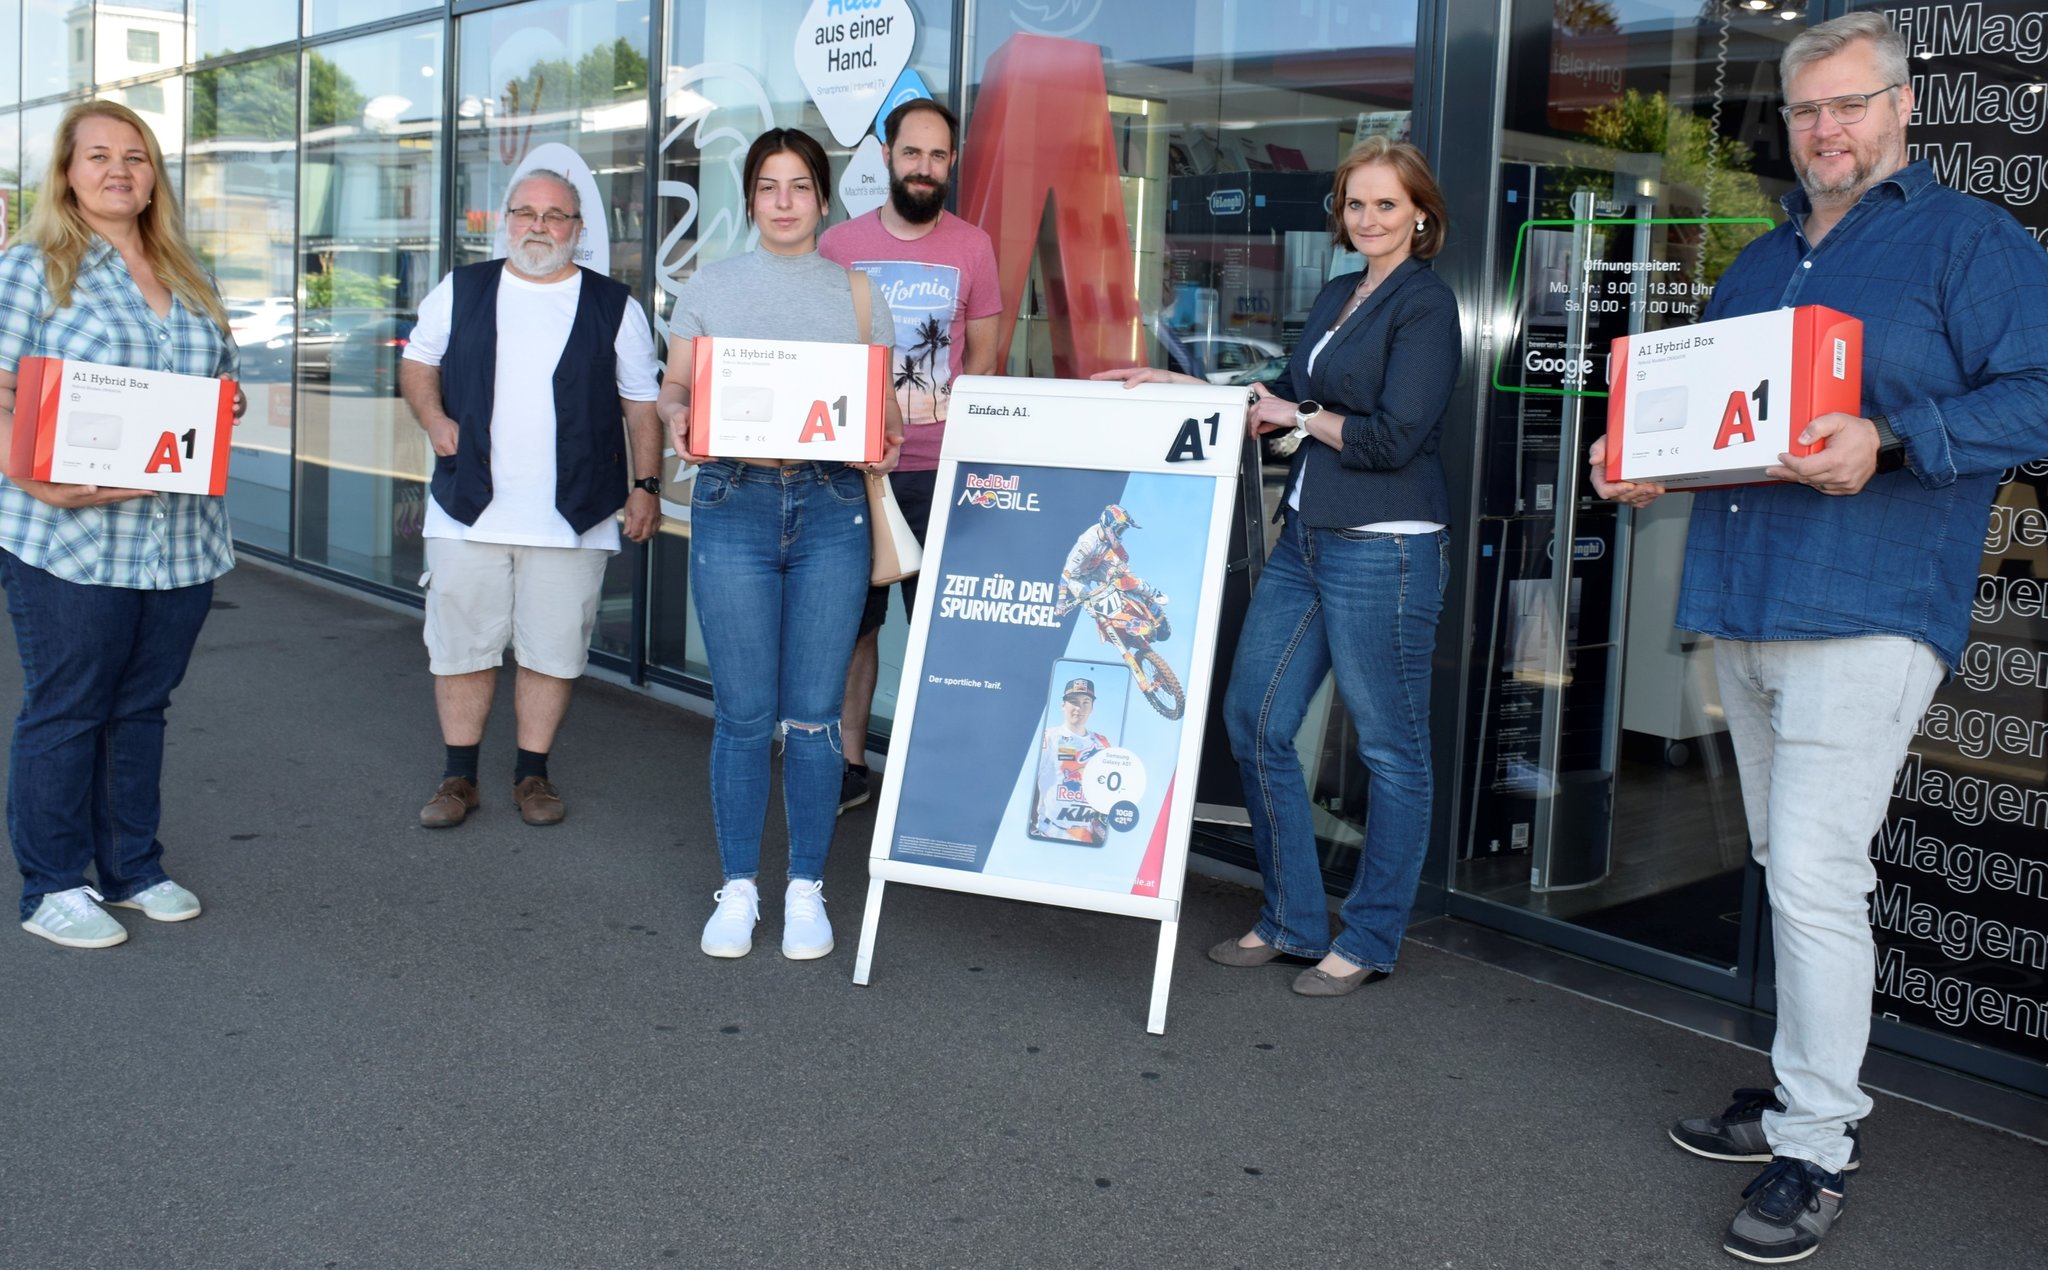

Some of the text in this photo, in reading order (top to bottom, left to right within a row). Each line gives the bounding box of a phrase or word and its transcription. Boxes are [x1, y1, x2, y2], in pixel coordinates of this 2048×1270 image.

[815, 14, 894, 45] aus einer
[828, 43, 877, 72] Hand.
[1550, 282, 1571, 294] Mo.
[1607, 282, 1637, 294] 9.00
[1650, 282, 1687, 295] 18.30
[1691, 283, 1714, 295] Uhr
[1590, 301, 1618, 312] 9.00
[1630, 301, 1668, 313] 17.00
[1672, 301, 1697, 314] Uhr
[723, 348, 797, 361] A1 Hybrid Box
[1638, 336, 1715, 357] A1 Hybrid Box
[1526, 350, 1594, 379] Google
[72, 371, 87, 382] A1
[91, 374, 126, 388] Hybrid
[130, 378, 149, 390] Box
[798, 395, 847, 443] A1
[968, 404, 1031, 417] Einfach A1.
[1713, 379, 1769, 450] A1
[144, 428, 197, 474] A1
[1165, 412, 1221, 463] A1
[957, 489, 1041, 512] MOBILE
[943, 573, 1054, 604] ZEIT FÜR DEN
[940, 597, 1061, 628] SPURWECHSEL.
[928, 675, 1002, 690] Der sportliche Tarif.
